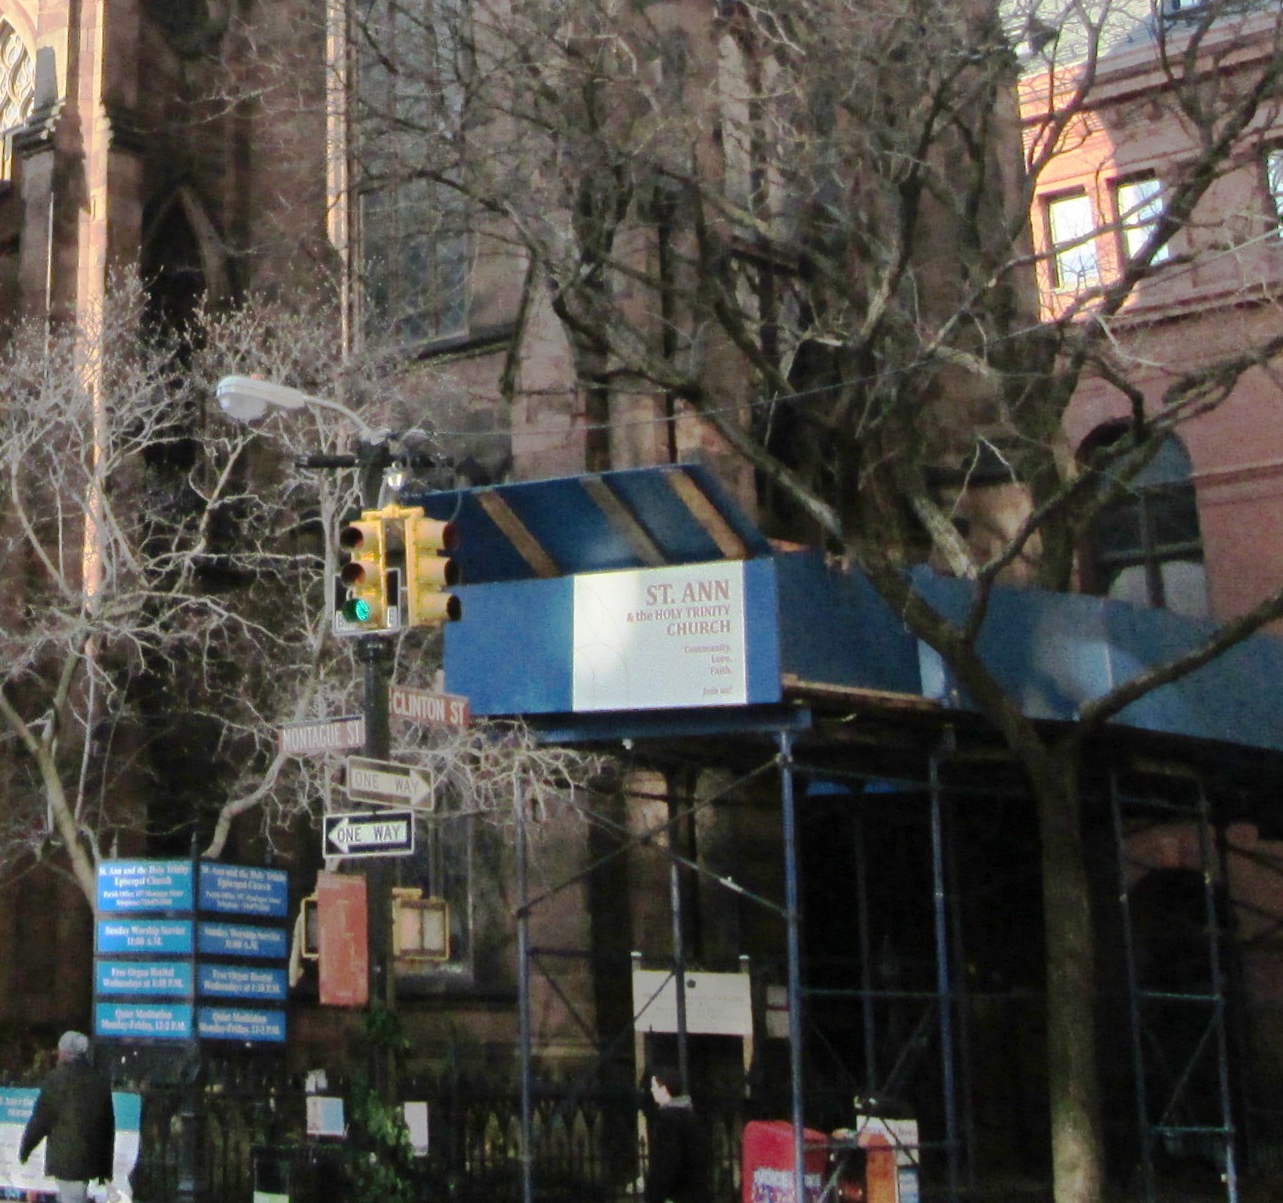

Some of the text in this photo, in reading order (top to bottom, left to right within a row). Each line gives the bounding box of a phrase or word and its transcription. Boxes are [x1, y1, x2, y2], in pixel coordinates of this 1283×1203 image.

[645, 579, 730, 606] ST. ANN
[626, 605, 731, 622] & the HOLY TRINITY
[667, 619, 731, 636] CHURCH
[392, 691, 465, 725] CLINTON ST
[283, 721, 361, 751] MONTAGUE ST
[354, 771, 420, 795] ONE WAY
[337, 825, 400, 844] ONE WAY
[123, 866, 136, 875] and
